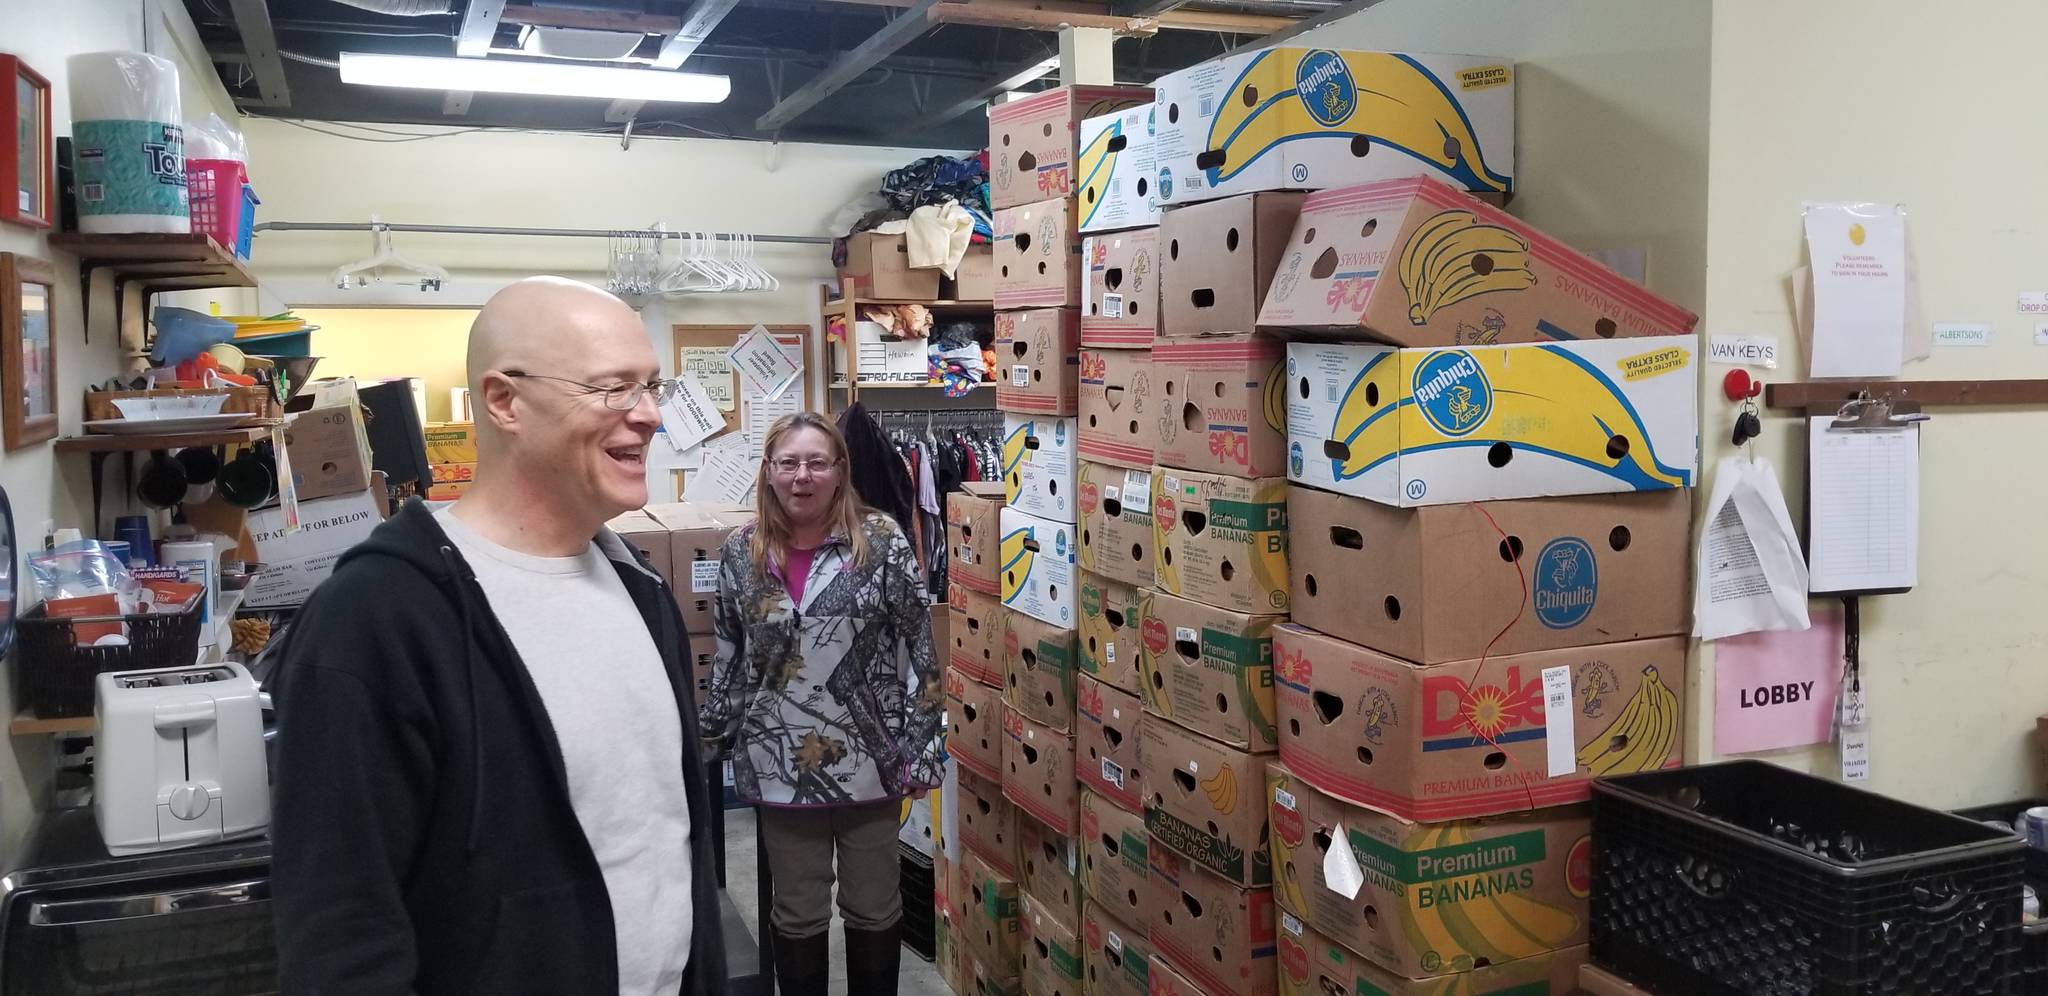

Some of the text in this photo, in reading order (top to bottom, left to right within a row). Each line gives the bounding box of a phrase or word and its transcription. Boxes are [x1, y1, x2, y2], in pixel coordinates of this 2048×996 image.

[1298, 56, 1346, 98] Chiquita
[1462, 68, 1504, 80] CLASS EXTRA
[1463, 79, 1483, 88] QUALITY
[1036, 148, 1067, 164] BANANAS
[1037, 167, 1069, 197] Dole
[1091, 239, 1107, 265] ole
[1339, 251, 1386, 267] BANANAS
[1326, 278, 1376, 314] Dole
[1555, 274, 1621, 317] BANANAS
[2021, 303, 2040, 312] DROP
[995, 312, 1015, 338] Dole
[1939, 328, 1984, 341] ALBERTSONS
[1626, 349, 1680, 370] CLASS EXTRA
[1711, 343, 1774, 360] VAN KEYS
[1080, 352, 1106, 379] Dole
[1626, 357, 1682, 379] SELECTED QUALITY
[1416, 354, 1477, 406] Chiquita
[686, 402, 708, 433] GOODWILL
[1207, 407, 1248, 422] BANANAS
[428, 440, 464, 448] BANANAS
[1208, 431, 1249, 466] Dole
[432, 464, 472, 481] Dole
[272, 528, 286, 540] AT
[313, 519, 330, 531] OR
[331, 511, 370, 527] BELOW
[1124, 512, 1153, 528] BANANA
[1211, 511, 1248, 528] Premium
[1211, 528, 1255, 545] BANANAS
[949, 585, 968, 610] Dole
[1535, 586, 1594, 614] Chiquita
[1203, 641, 1237, 661] Premium
[1273, 641, 1313, 686] Dole
[1203, 656, 1237, 677] BANANA
[947, 671, 964, 699] Dole
[1740, 681, 1815, 709] LOBBY
[1423, 665, 1547, 739] Dole
[1003, 706, 1024, 737] Dole
[1423, 768, 1548, 796] PREMIUM BANAN
[1160, 812, 1211, 849] BANANAS
[1150, 819, 1186, 849] CERTIFIED
[1186, 839, 1228, 873] ORGANIC
[1352, 844, 1397, 876] Premium
[1416, 844, 1517, 878] Premium
[1361, 866, 1405, 898] NANAS
[1418, 868, 1534, 909] BANANAS
